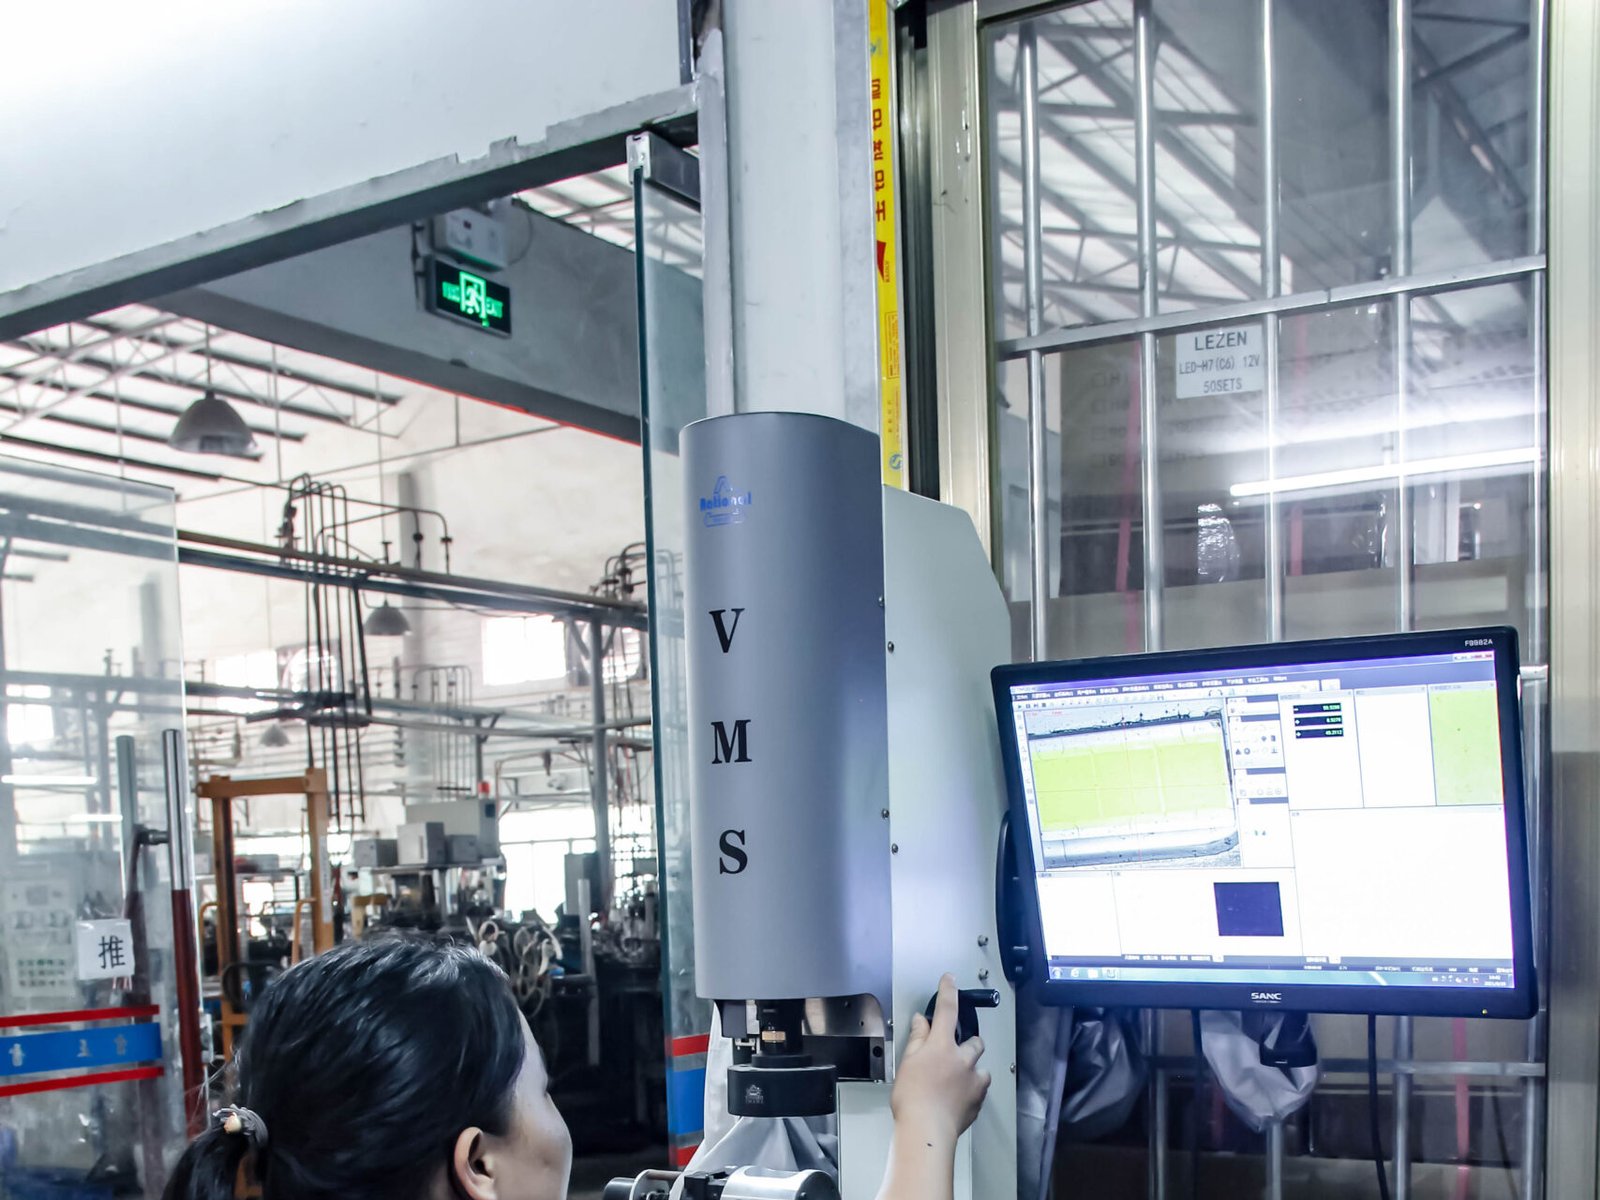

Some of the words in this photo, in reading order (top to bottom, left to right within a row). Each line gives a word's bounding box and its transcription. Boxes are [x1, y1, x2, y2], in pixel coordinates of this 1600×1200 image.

[1194, 331, 1247, 351] LEZEN
[1243, 354, 1260, 368] 12V
[1203, 378, 1243, 394] 50SETS
[98, 934, 126, 970] 推
[1250, 992, 1282, 1000] SANC
